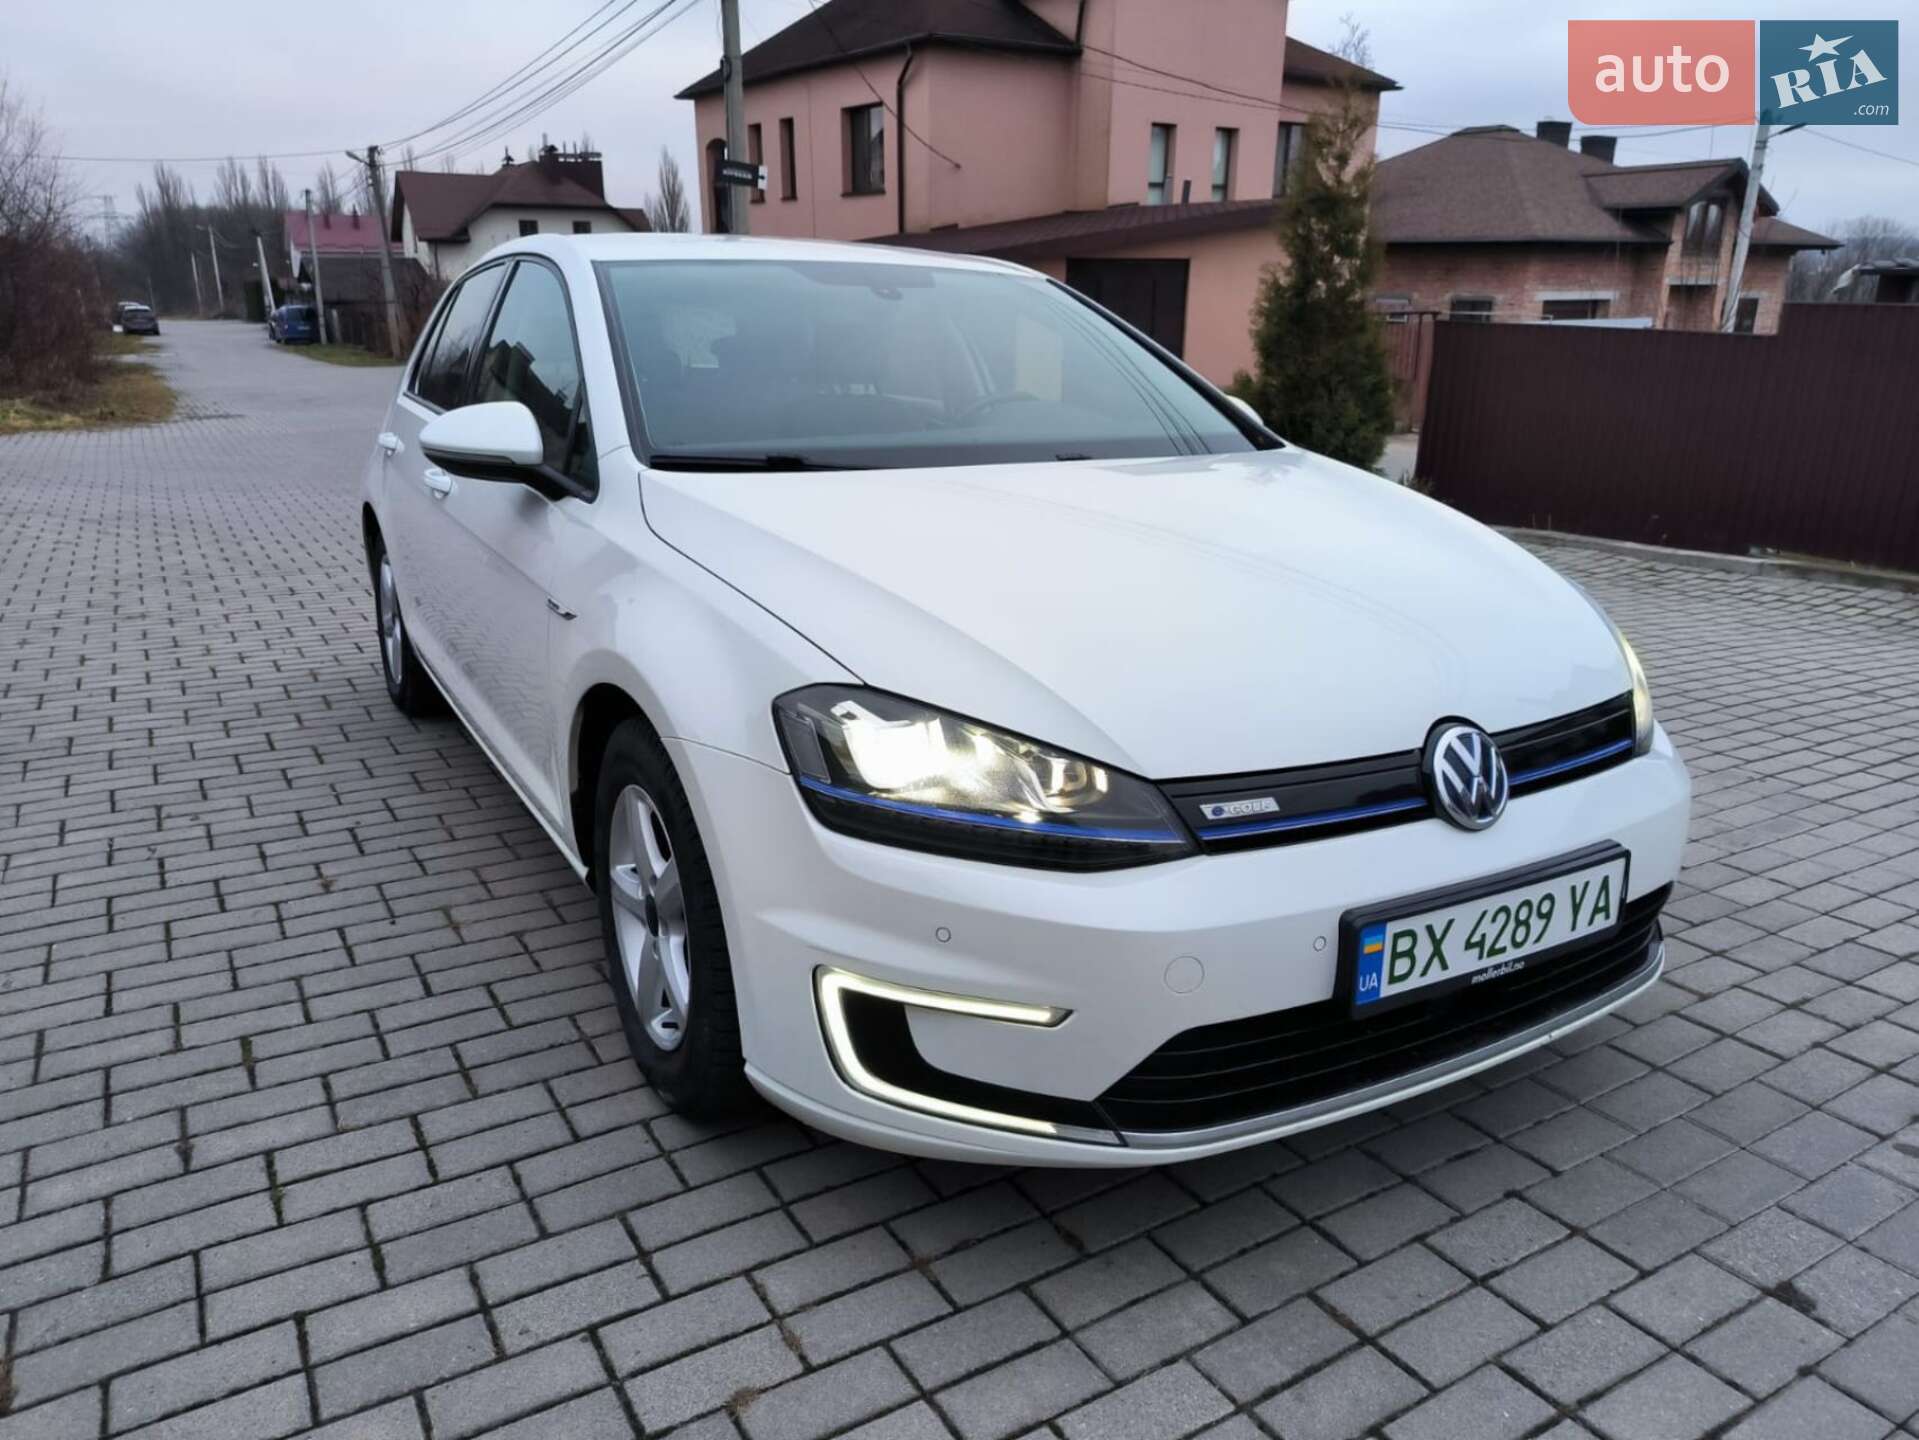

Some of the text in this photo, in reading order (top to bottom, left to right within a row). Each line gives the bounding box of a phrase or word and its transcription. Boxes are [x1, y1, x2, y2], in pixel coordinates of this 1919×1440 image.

[1388, 875, 1611, 985] BX 4289 YA
[1359, 972, 1378, 992] UA
